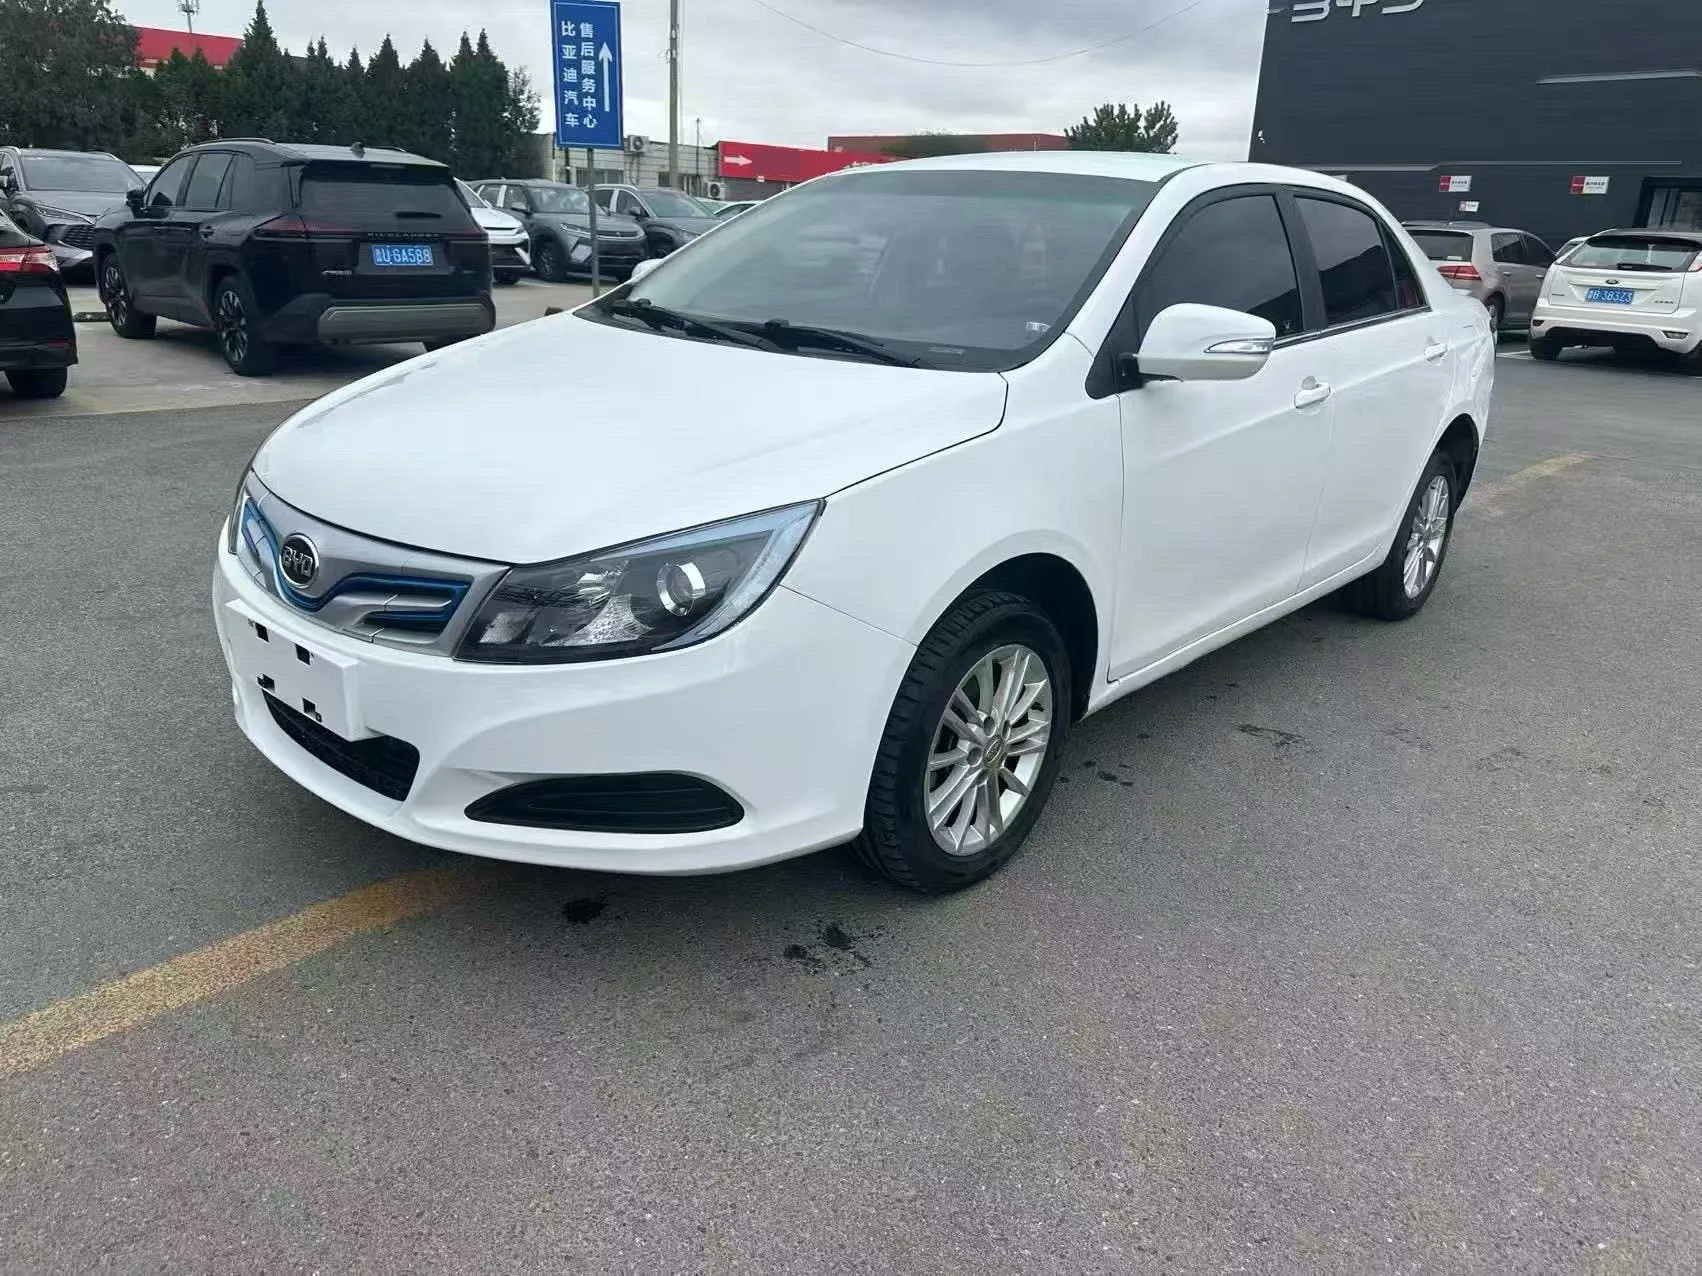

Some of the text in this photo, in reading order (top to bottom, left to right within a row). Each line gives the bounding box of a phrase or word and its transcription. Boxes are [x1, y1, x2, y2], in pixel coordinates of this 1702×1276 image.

[561, 20, 579, 128] 比亚迪汽车
[580, 22, 597, 129] 售后服务中心
[283, 545, 313, 577] BYD
